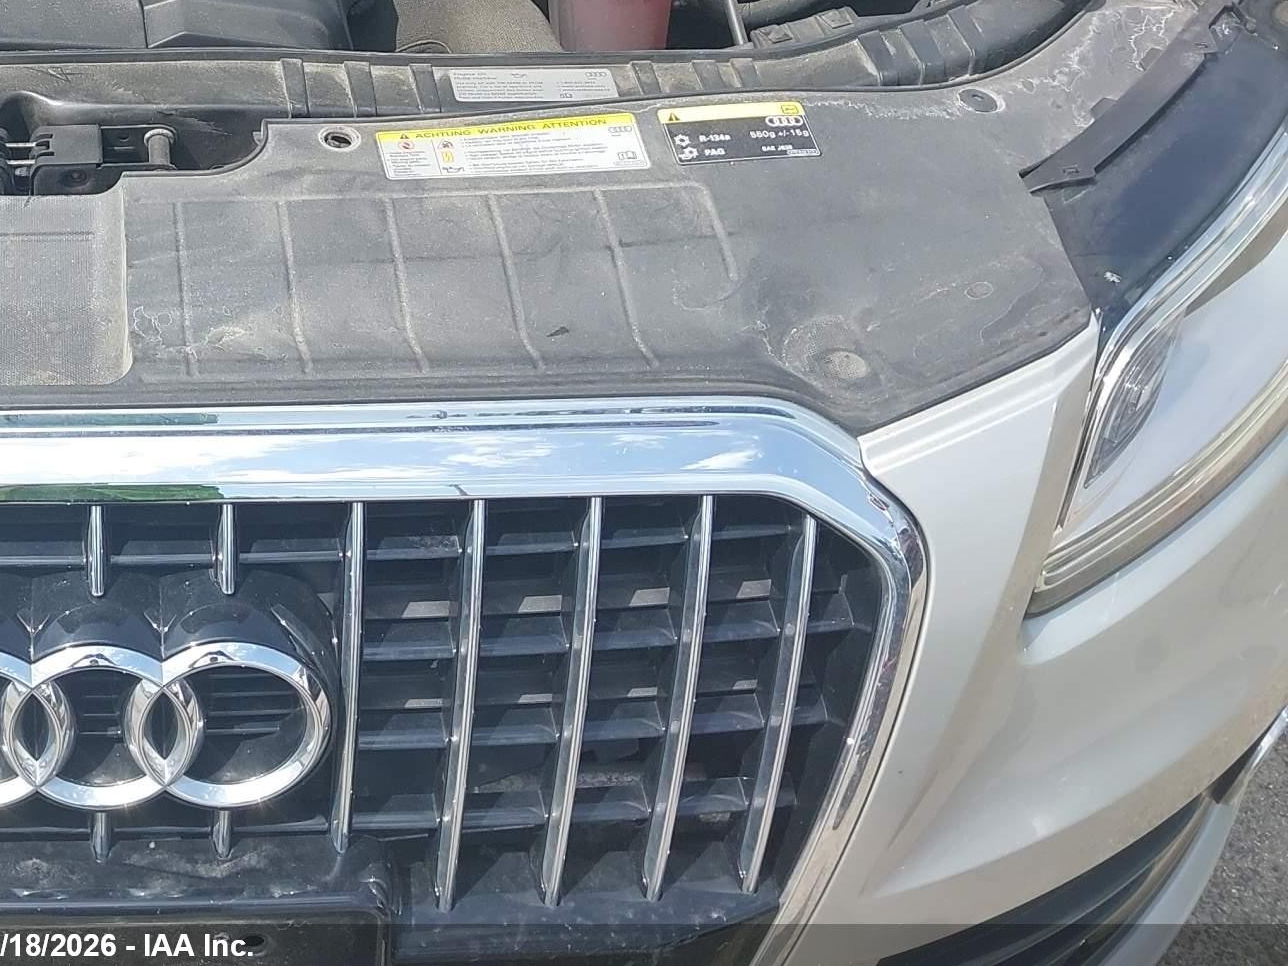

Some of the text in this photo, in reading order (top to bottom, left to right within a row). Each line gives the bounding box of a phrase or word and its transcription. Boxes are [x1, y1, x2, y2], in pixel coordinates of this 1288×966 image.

[416, 119, 607, 139] ACHTUNG WARNING ATTENTION
[699, 133, 731, 142] R-134a
[703, 147, 725, 156] PAG
